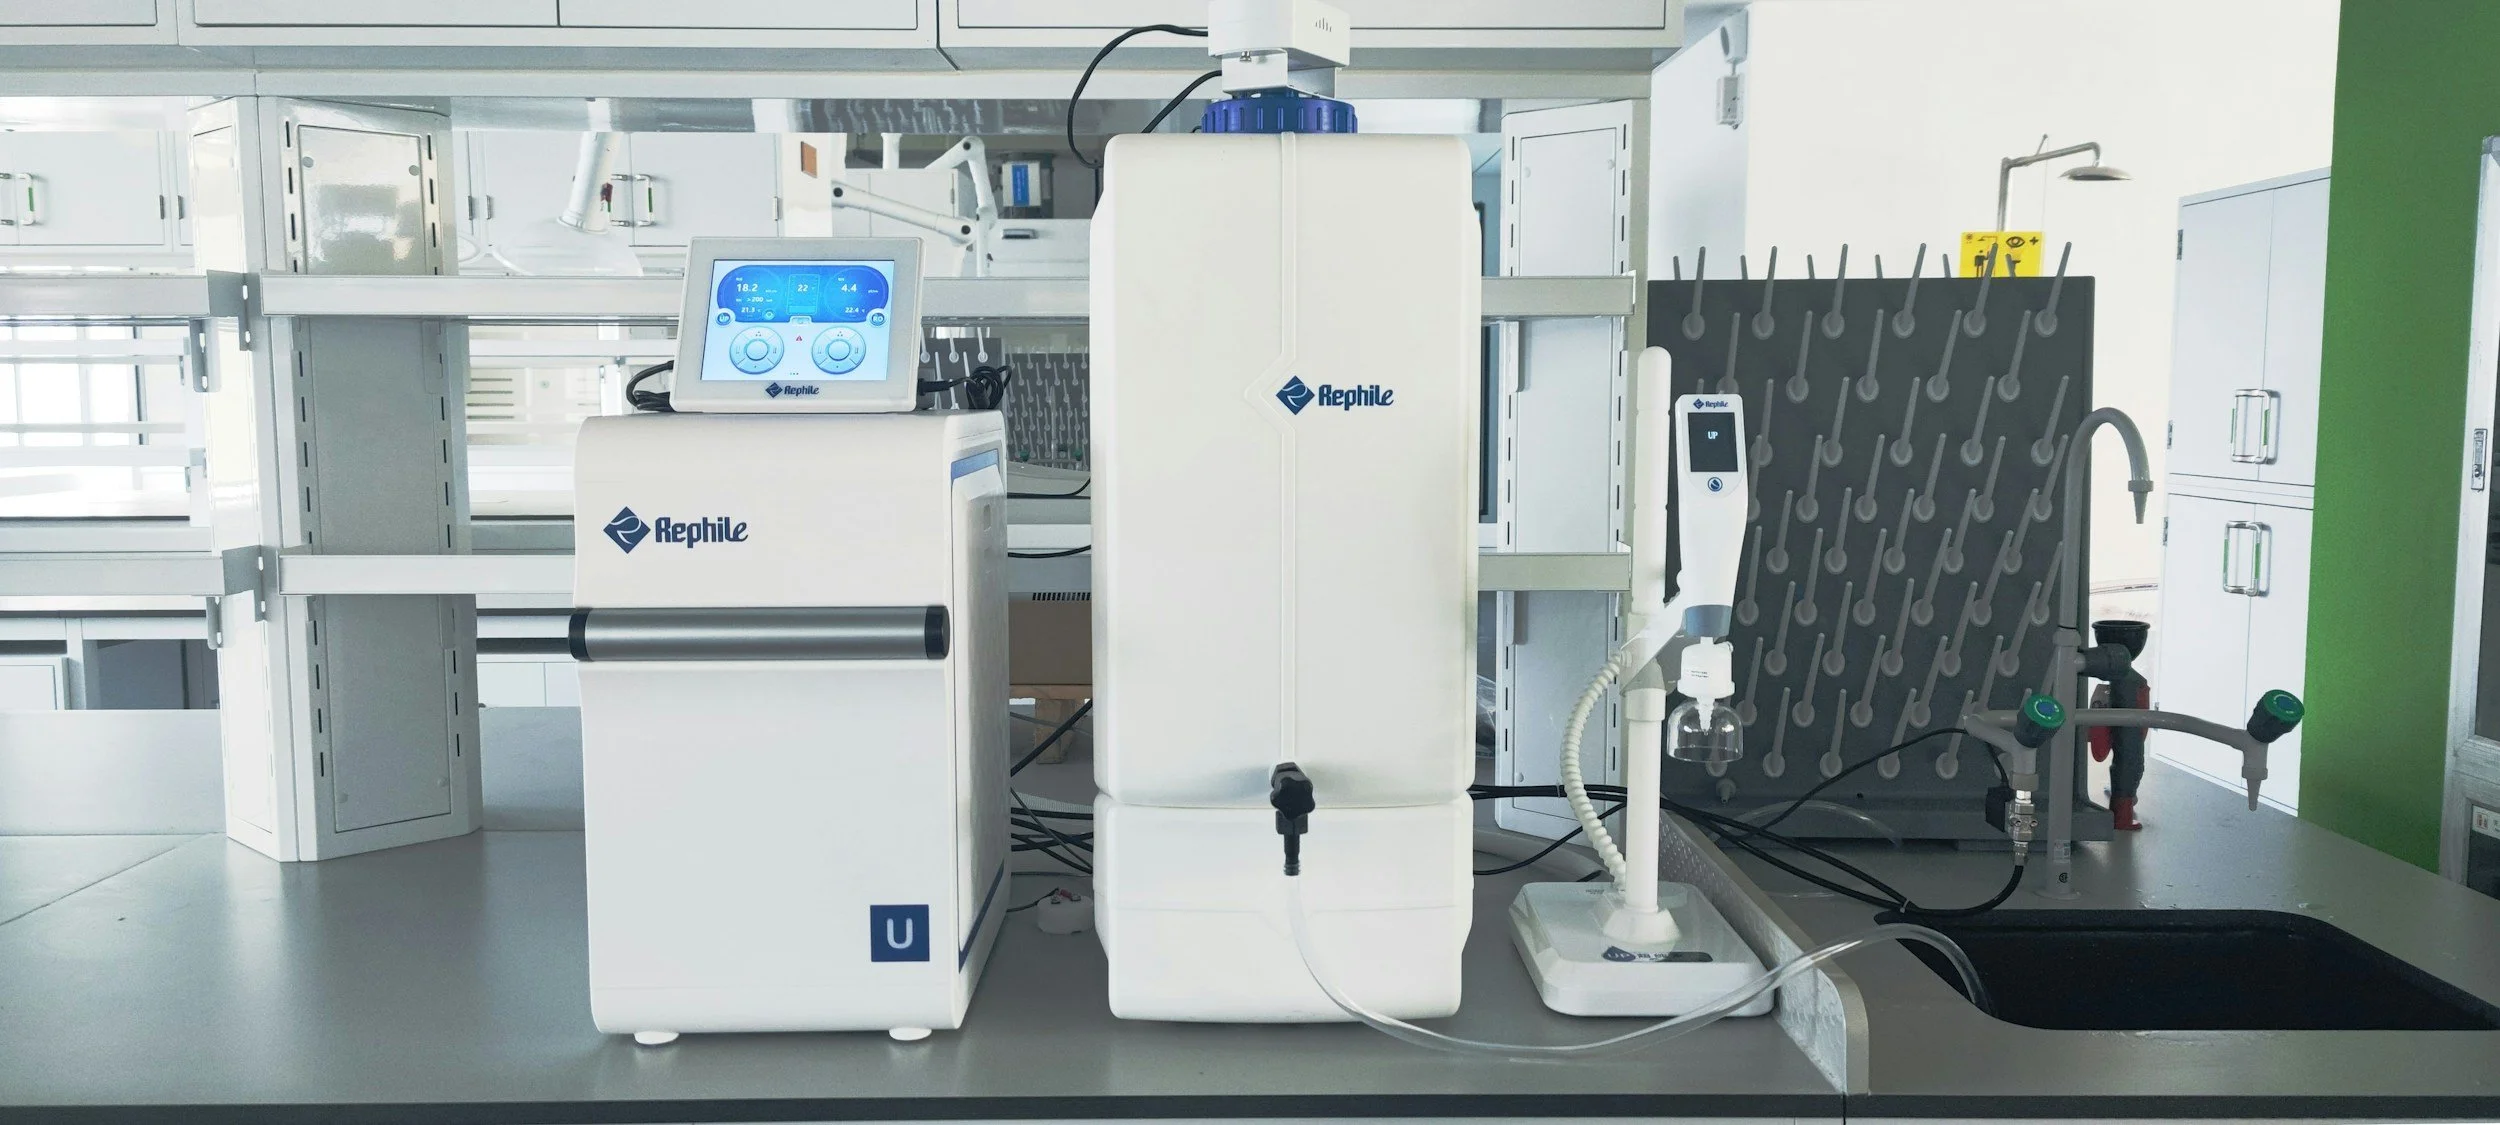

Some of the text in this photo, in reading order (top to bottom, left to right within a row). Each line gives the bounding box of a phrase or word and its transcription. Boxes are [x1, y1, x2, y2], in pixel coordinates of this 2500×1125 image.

[736, 283, 759, 292] 18.2
[797, 284, 809, 292] 22
[841, 283, 857, 293] 4.4
[784, 385, 820, 397] Rephile
[1318, 383, 1395, 411] Rephile
[1708, 431, 1718, 439] UP
[655, 515, 749, 549] Rephile
[886, 917, 913, 950] U
